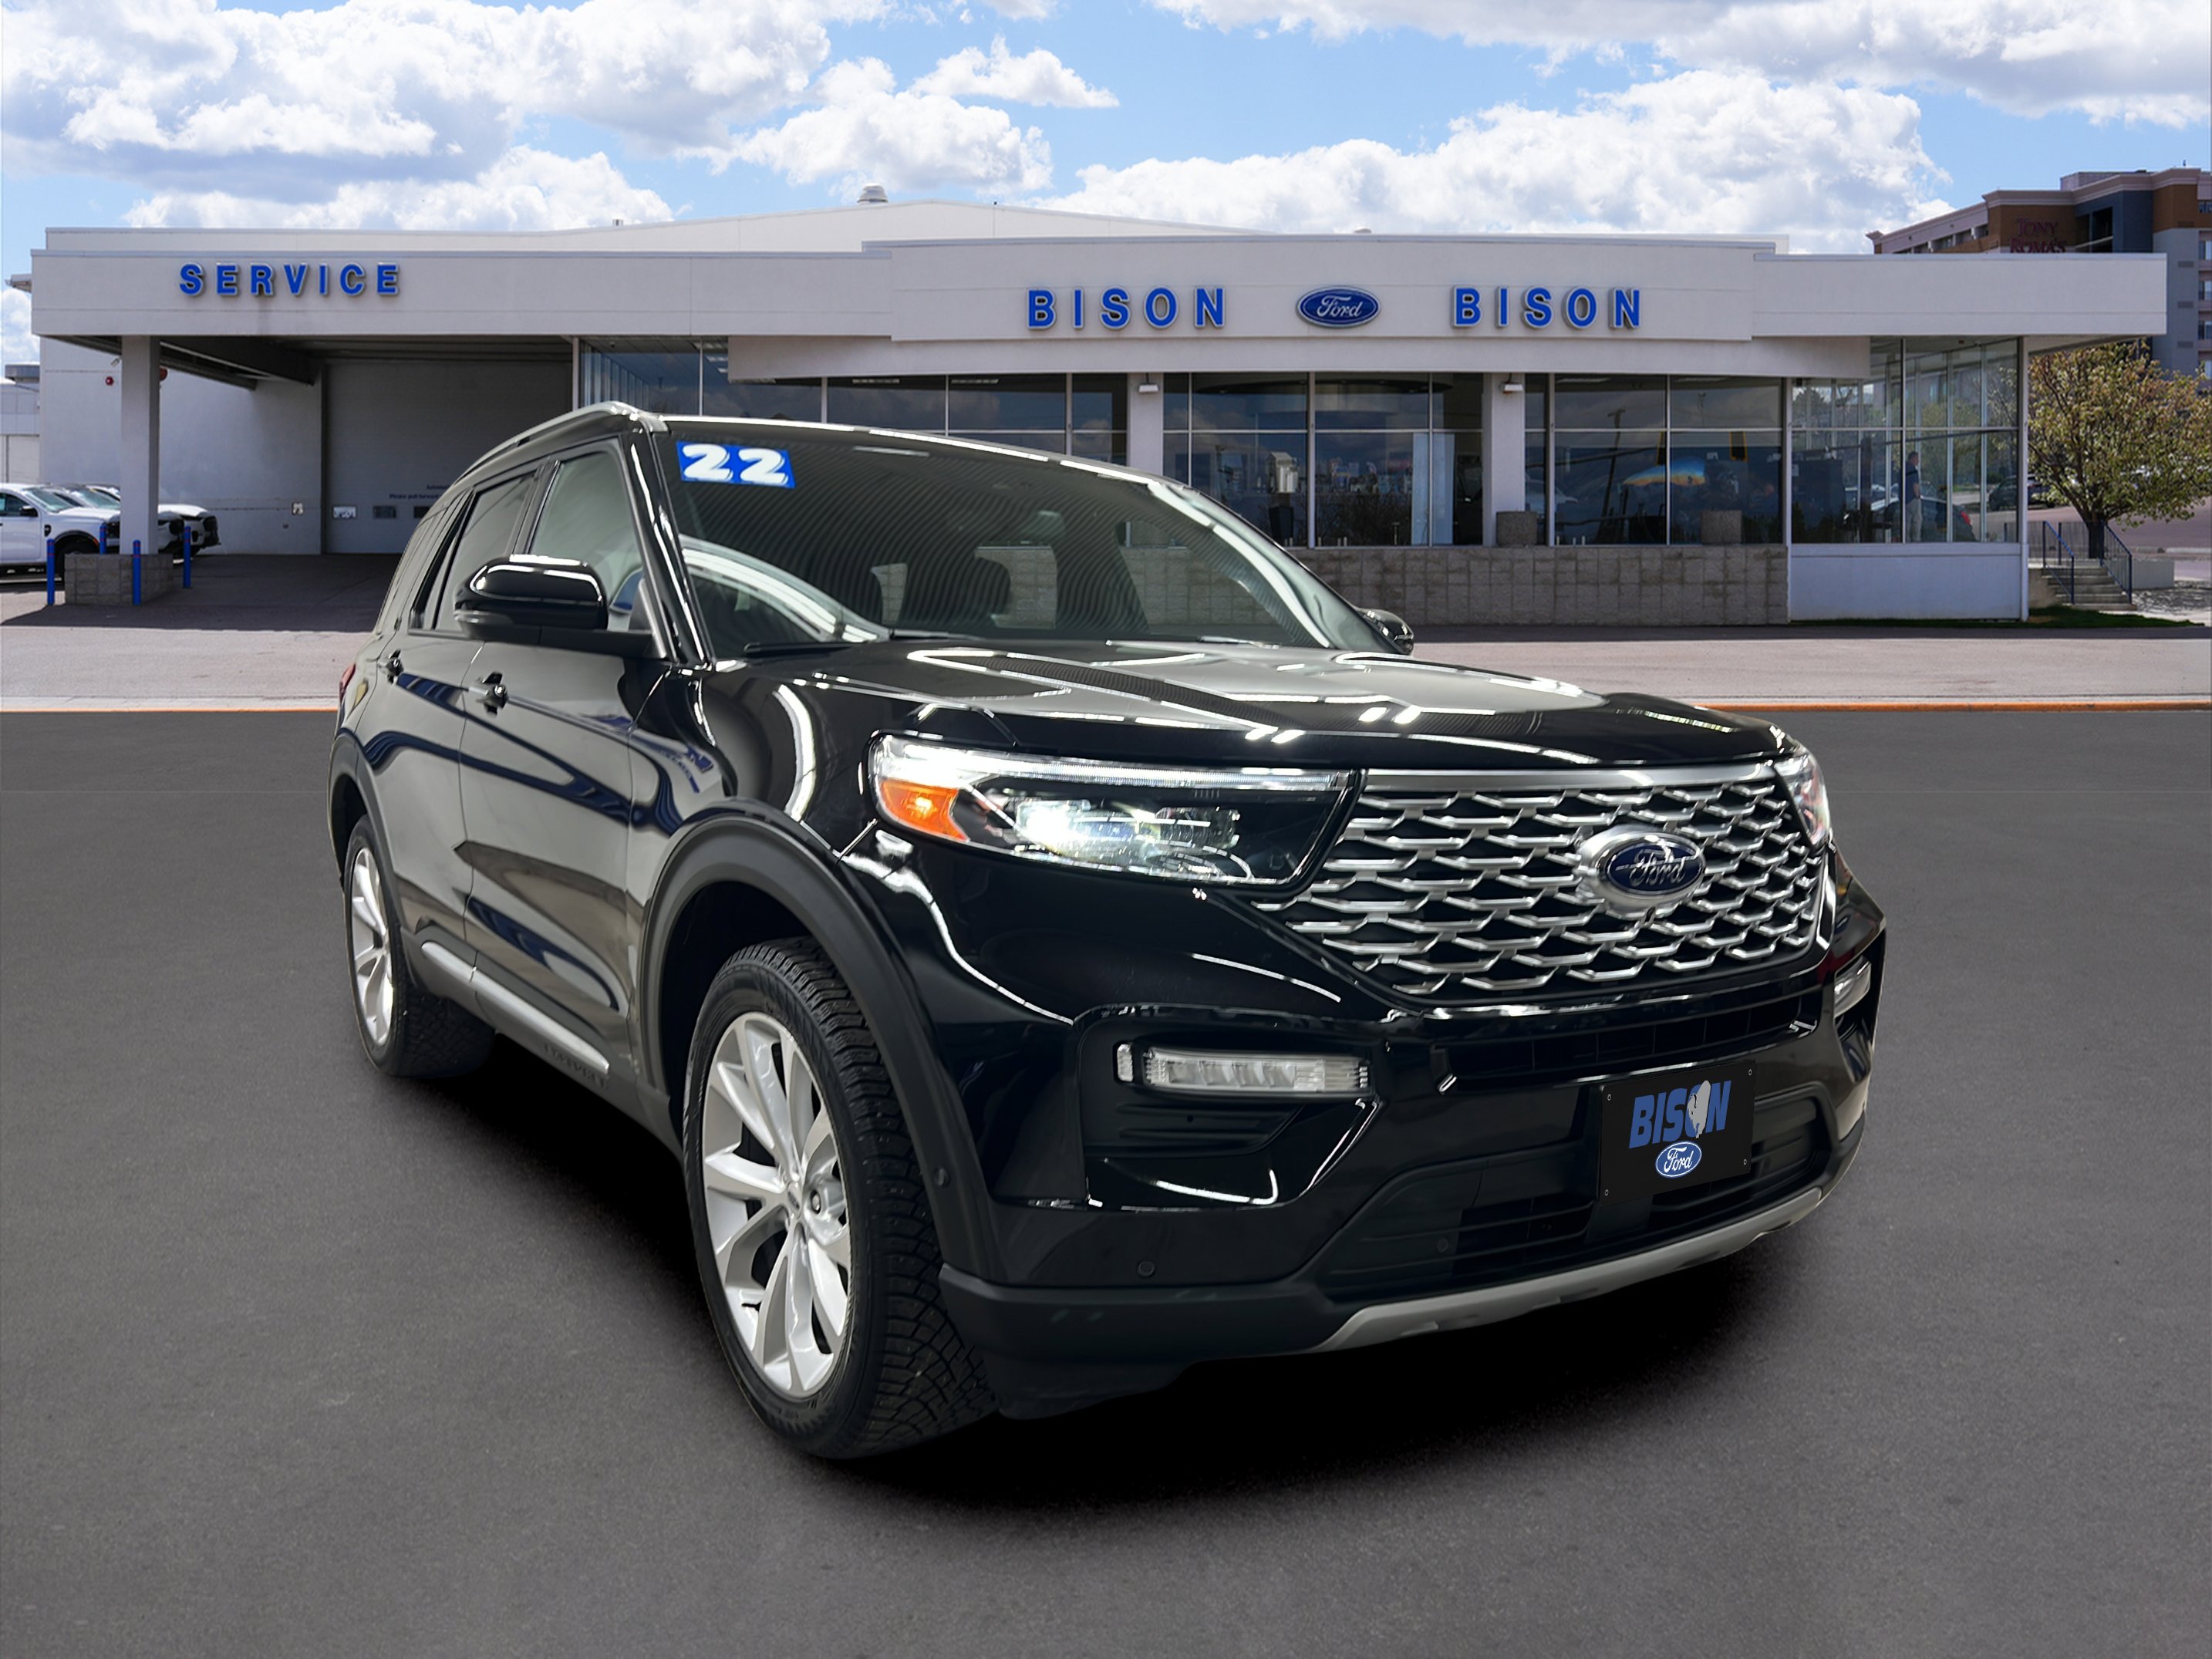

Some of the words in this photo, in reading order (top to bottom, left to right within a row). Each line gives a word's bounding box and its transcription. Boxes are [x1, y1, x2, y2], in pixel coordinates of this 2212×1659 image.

[2015, 218, 2059, 236] TONY
[178, 262, 400, 296] SERVICE
[1027, 286, 1225, 329] BISON
[1316, 295, 1364, 318] Ford
[1452, 286, 1641, 329] BISON
[682, 443, 789, 486] 22
[1629, 848, 1686, 886] Ford
[1664, 1146, 1694, 1173] Ford
